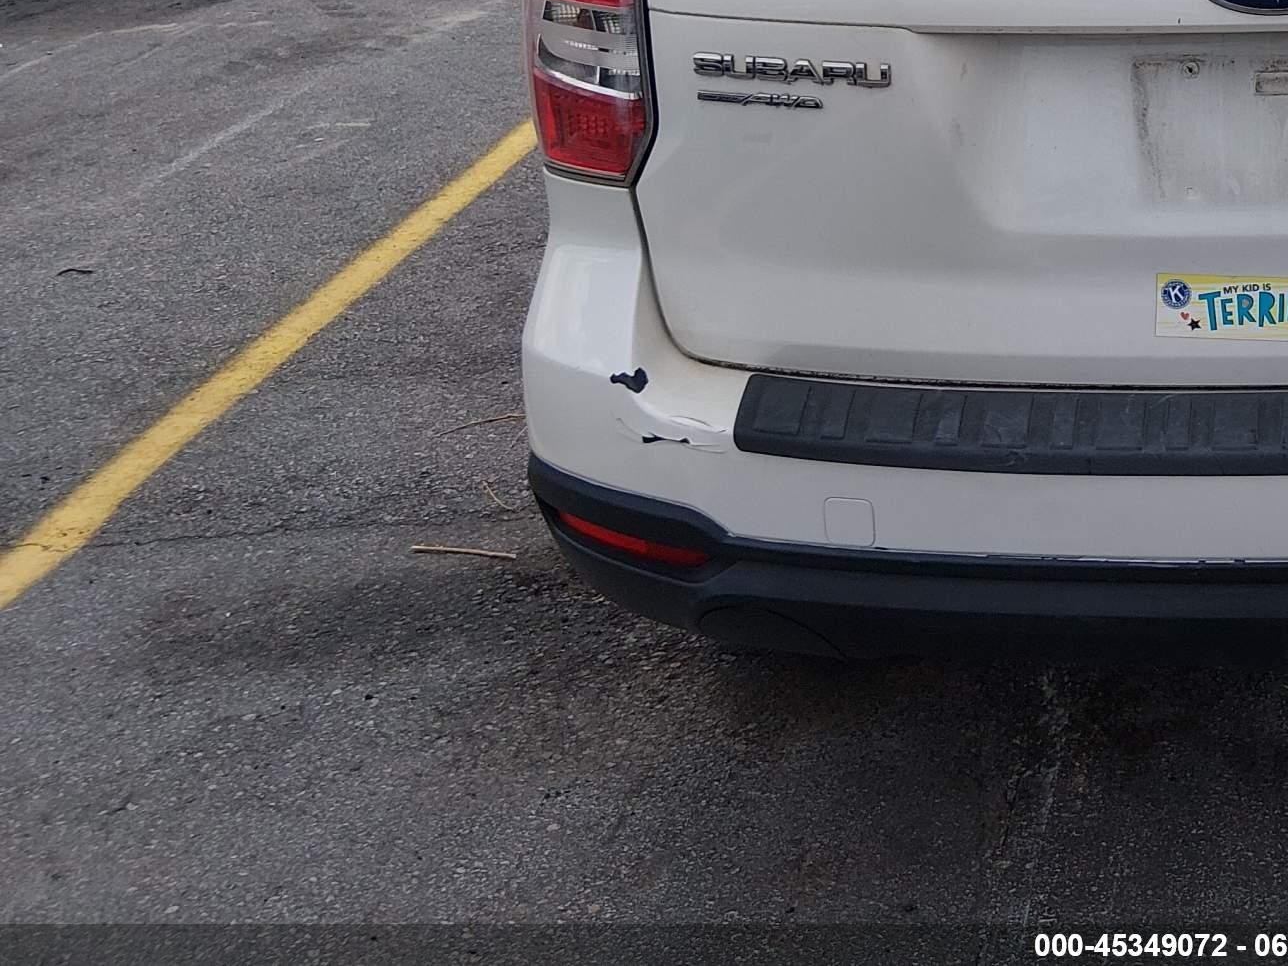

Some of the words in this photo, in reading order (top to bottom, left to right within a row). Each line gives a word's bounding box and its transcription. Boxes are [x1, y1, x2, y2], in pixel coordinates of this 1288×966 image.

[693, 51, 892, 88] SUBARU
[1223, 285, 1239, 294] MY
[1242, 284, 1260, 293] KID
[1262, 283, 1272, 291] IS
